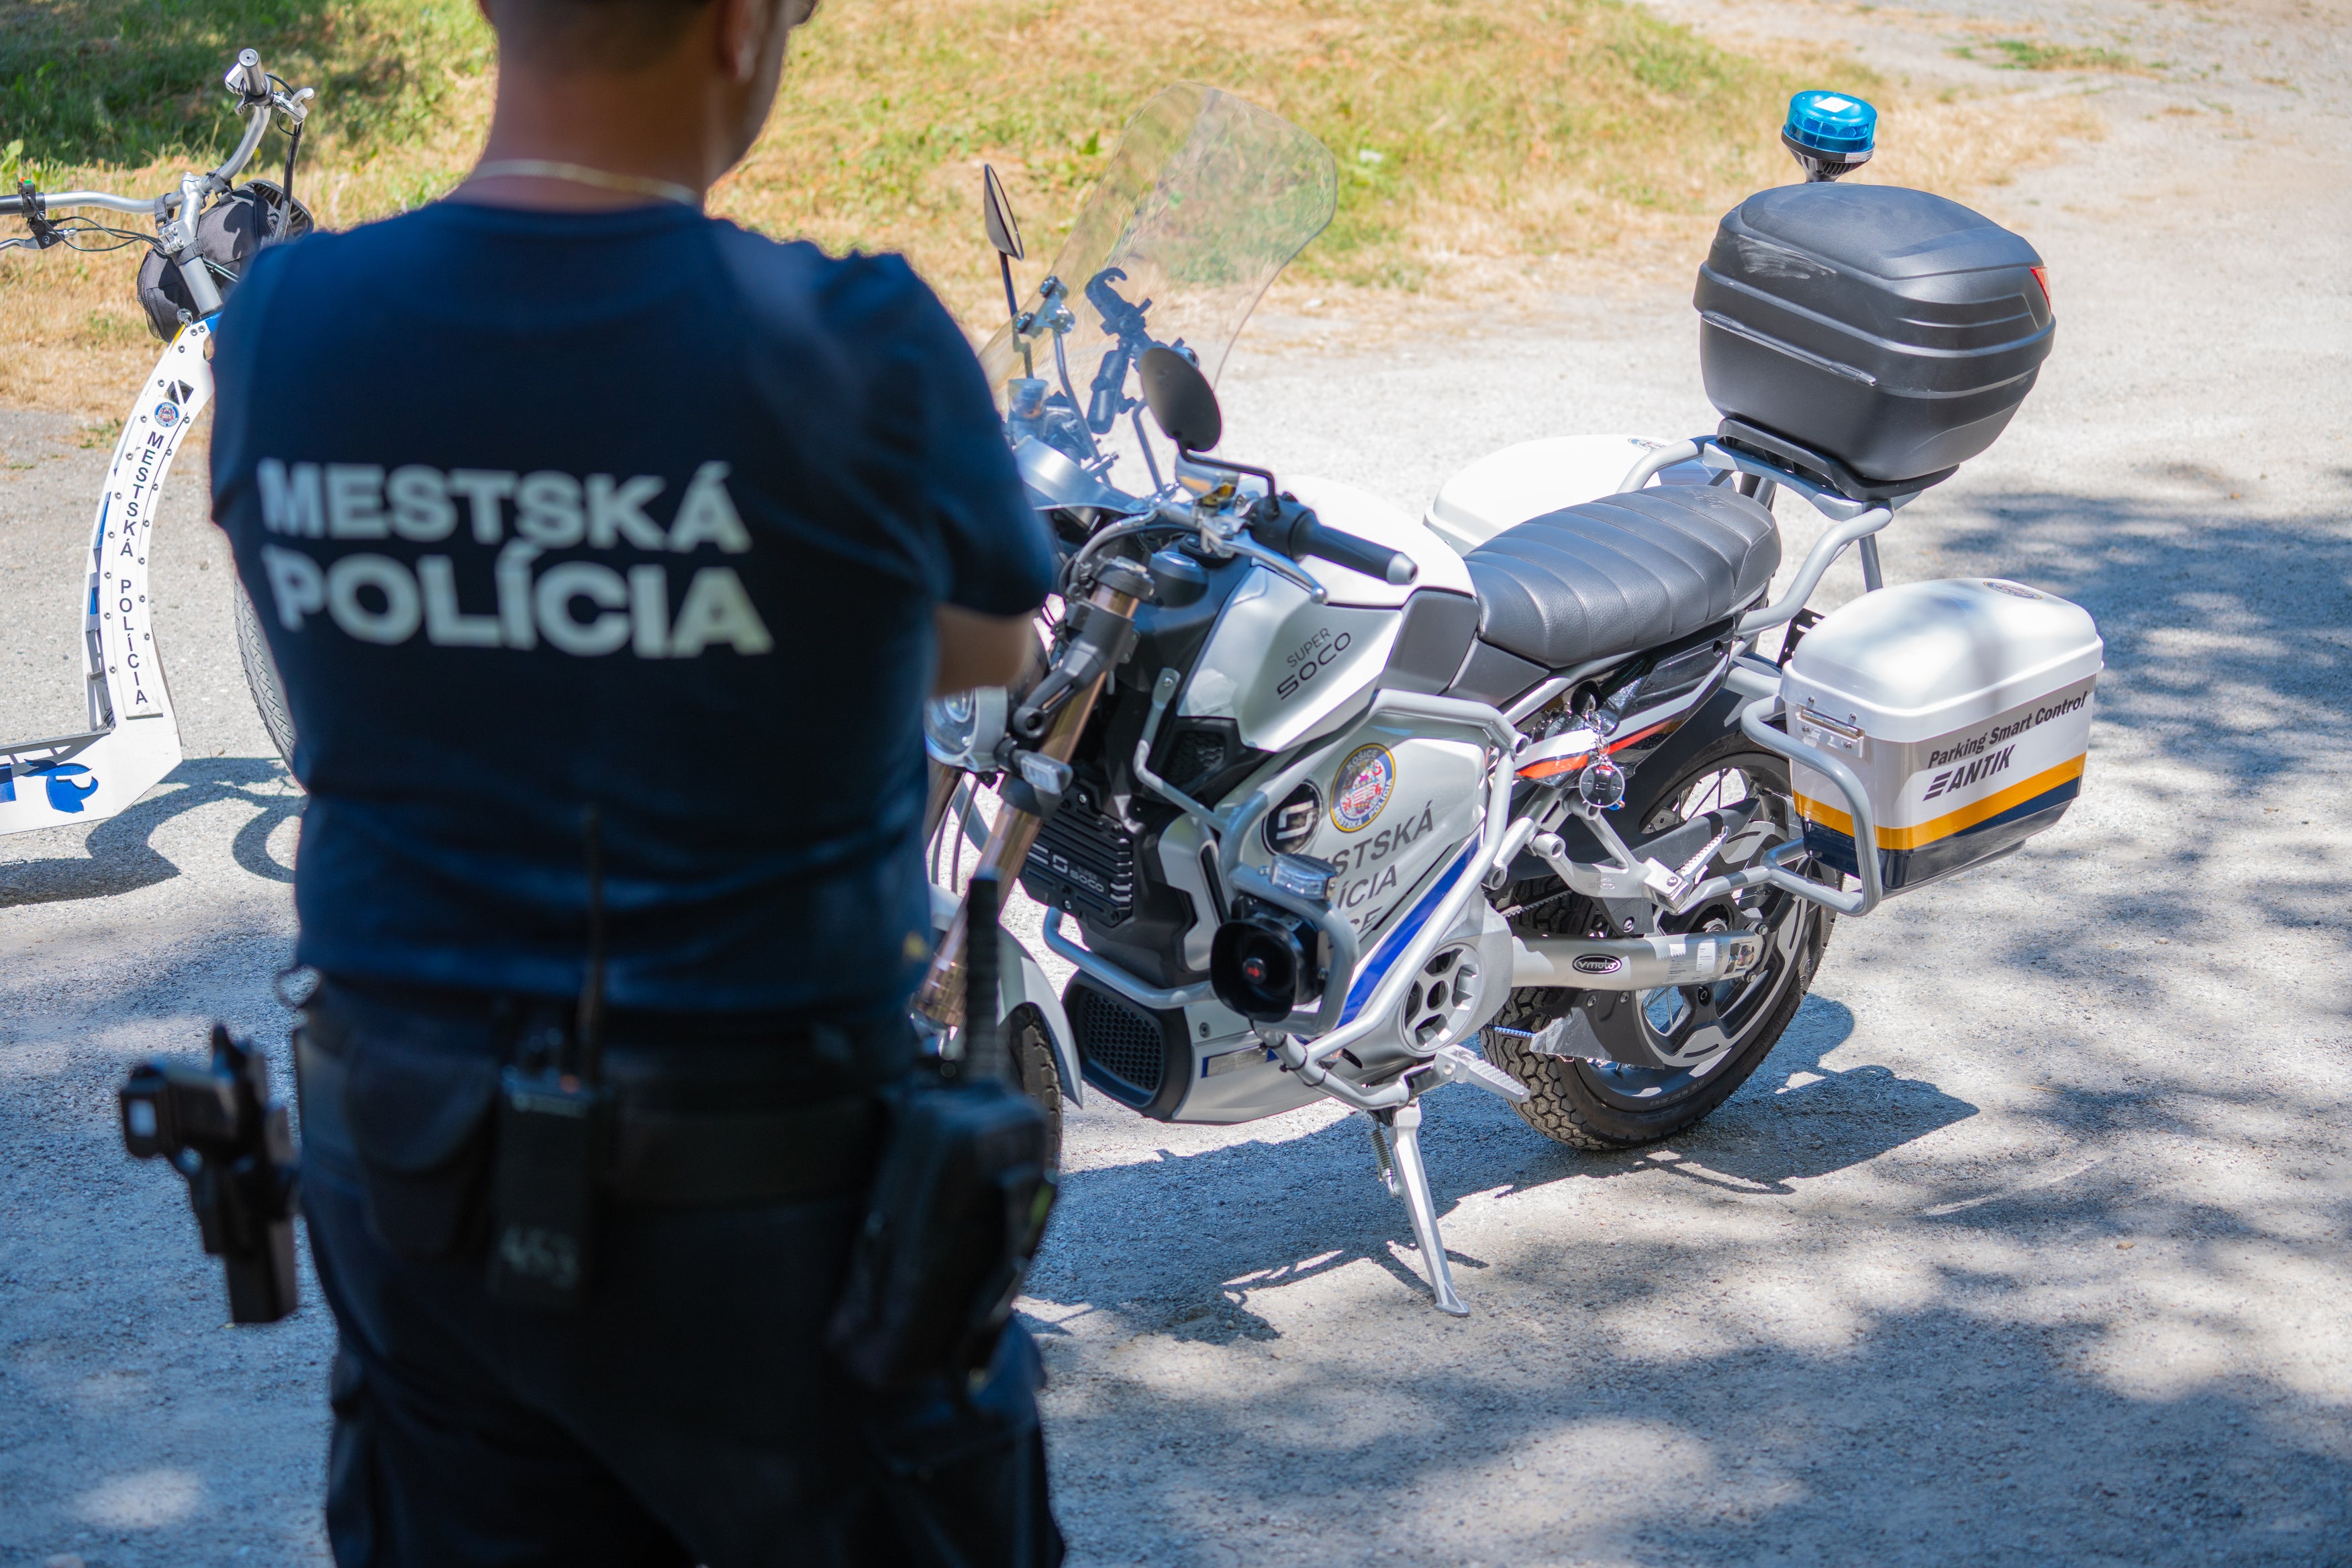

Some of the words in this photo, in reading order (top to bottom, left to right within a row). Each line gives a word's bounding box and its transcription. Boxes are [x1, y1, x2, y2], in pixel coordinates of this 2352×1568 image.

[120, 431, 164, 557] MESTSKÁ
[258, 458, 752, 553] MESTSKÁ
[260, 540, 773, 658] POLÍCIA
[119, 579, 148, 705] POLÍCIA
[1277, 632, 1351, 701] SOCO
[1286, 628, 1331, 668] SUPER
[1928, 732, 1988, 769] Parking
[1989, 713, 2032, 745] Smart
[2035, 691, 2088, 726] Control
[1324, 799, 1434, 878] STSKÁ
[1069, 869, 1105, 893] SOCO
[1337, 864, 1397, 909] ÍCIA
